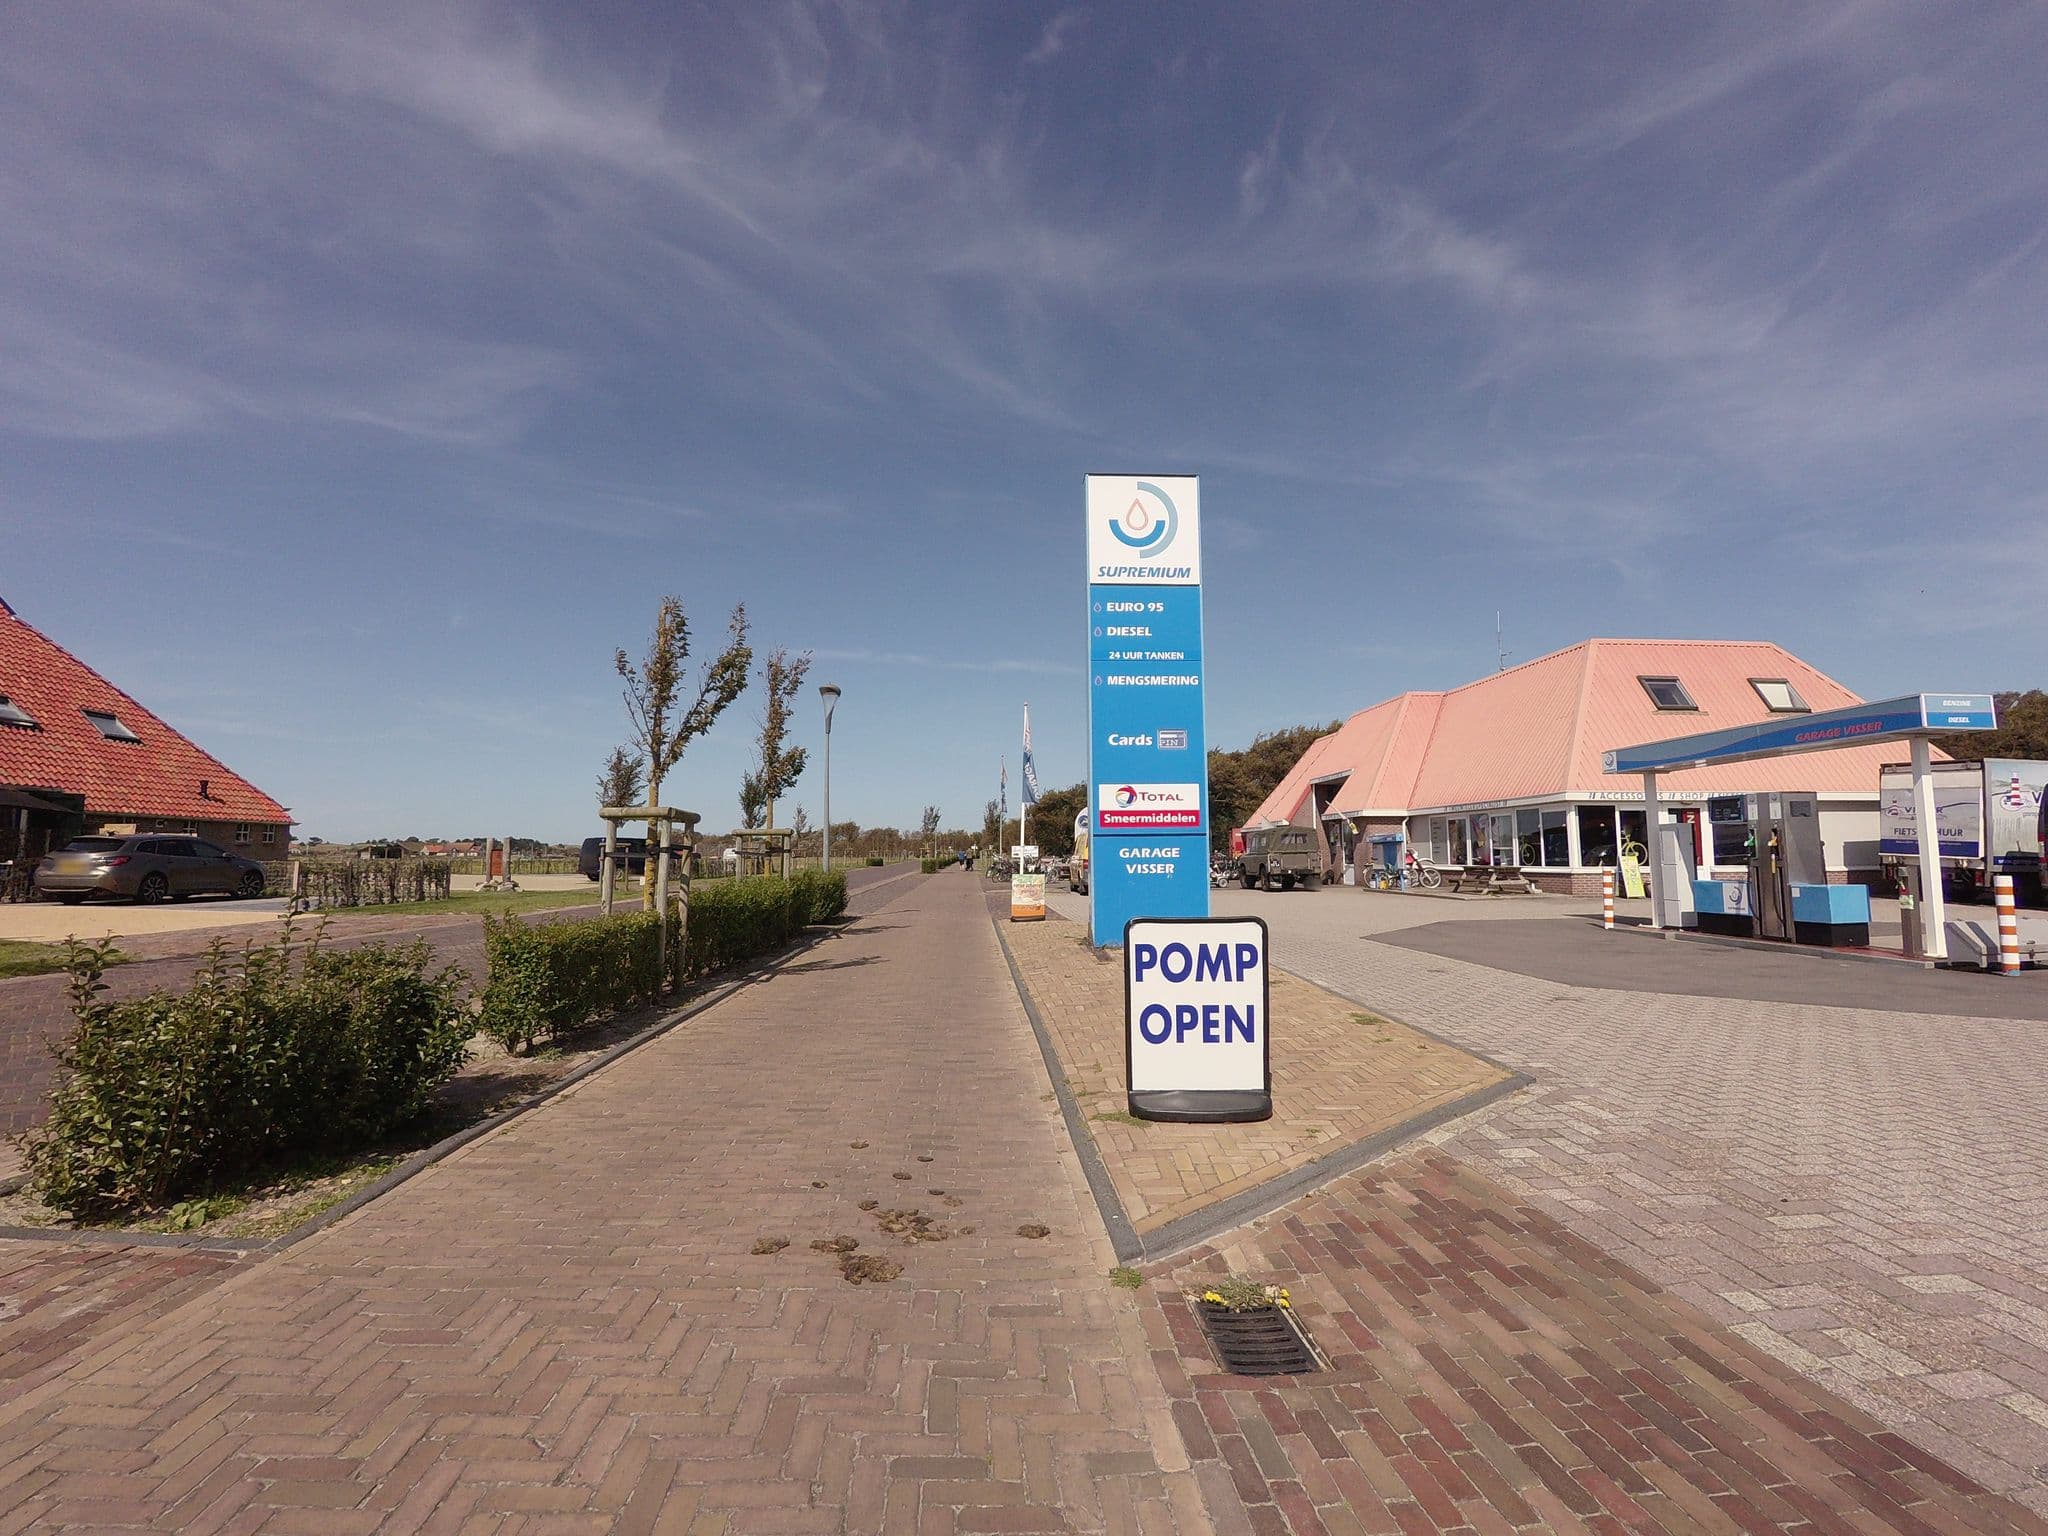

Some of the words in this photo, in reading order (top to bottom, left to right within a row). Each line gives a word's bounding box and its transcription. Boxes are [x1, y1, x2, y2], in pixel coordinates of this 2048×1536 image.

[1098, 566, 1191, 579] SUPREMIUM
[1106, 602, 1144, 612] EURO
[1147, 602, 1164, 612] 95
[1106, 626, 1152, 637] DIESEL
[1108, 651, 1121, 659] 24
[1122, 651, 1143, 660] UUR
[1144, 651, 1184, 660] TANKEN
[1107, 675, 1199, 686] MENGSMERING
[1795, 727, 1841, 743] GARAGE
[1843, 720, 1883, 737] VISSER
[1108, 733, 1153, 746] Cards
[1138, 791, 1184, 801] TOTAL
[1600, 792, 1664, 800] ACCESSOS
[1679, 792, 1703, 800] SHOP
[1104, 813, 1196, 824] Smeermiddelen
[1119, 847, 1180, 858] GARAGE
[1126, 863, 1175, 874] VISSER
[1134, 942, 1259, 983] POMP
[1139, 1003, 1255, 1045] OPEN
